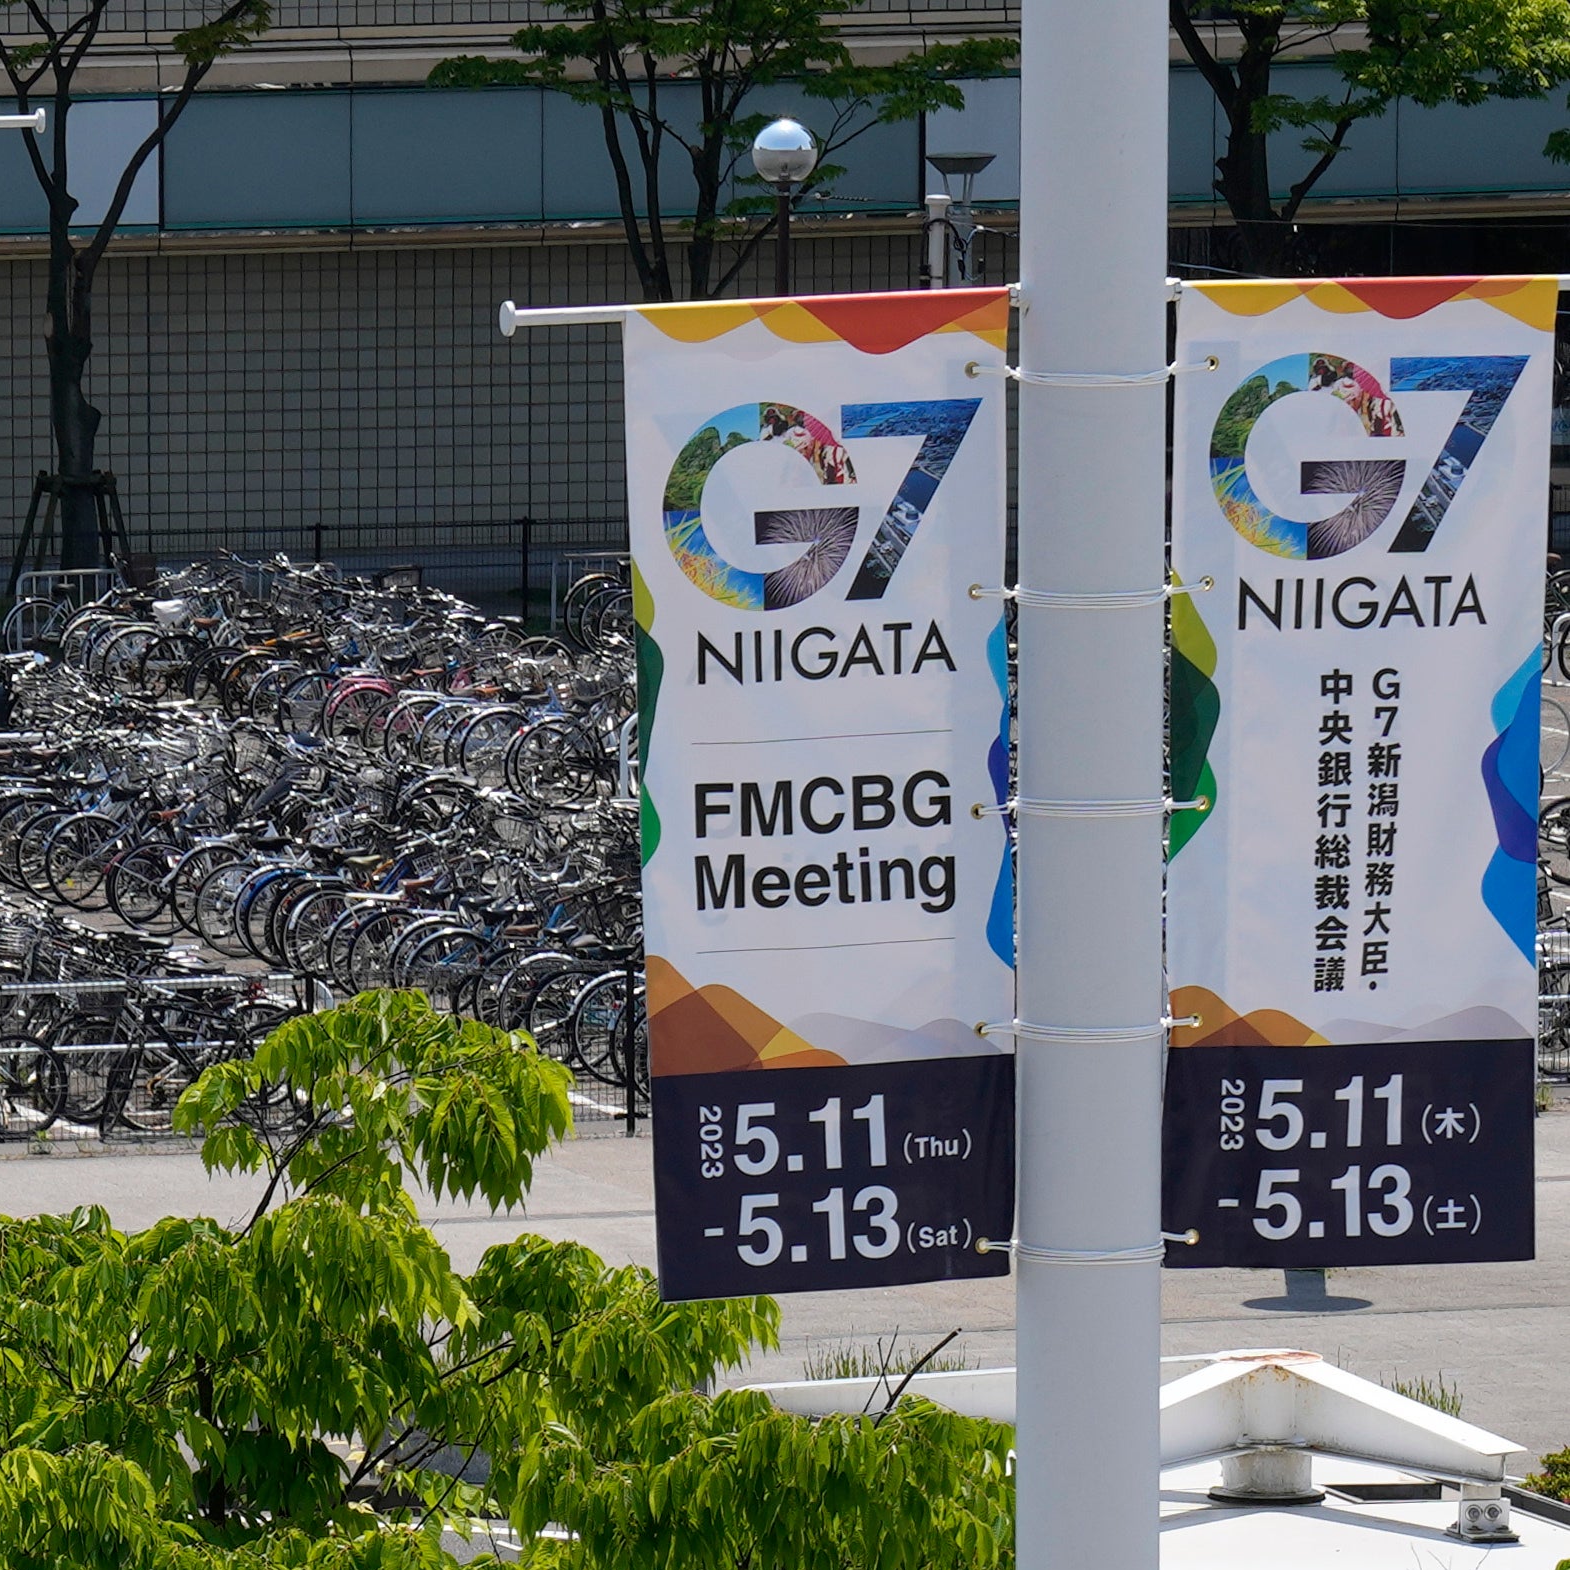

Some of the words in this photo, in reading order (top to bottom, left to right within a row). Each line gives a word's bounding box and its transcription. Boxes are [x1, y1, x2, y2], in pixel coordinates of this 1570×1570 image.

[1210, 352, 1531, 561] G7
[663, 398, 985, 611] G7
[1239, 574, 1486, 631] NIIGATA
[698, 620, 957, 685] NIIGATA
[695, 771, 951, 838] FMCBG
[1314, 669, 1352, 992] 中央銀行総裁会議
[695, 847, 955, 913] Meeting
[700, 1106, 724, 1178] 2023
[734, 1095, 886, 1175] 5.11
[1221, 1079, 1245, 1150] 2023
[1256, 1074, 1402, 1150] 5.11
[1219, 1165, 1413, 1239] -5.13
